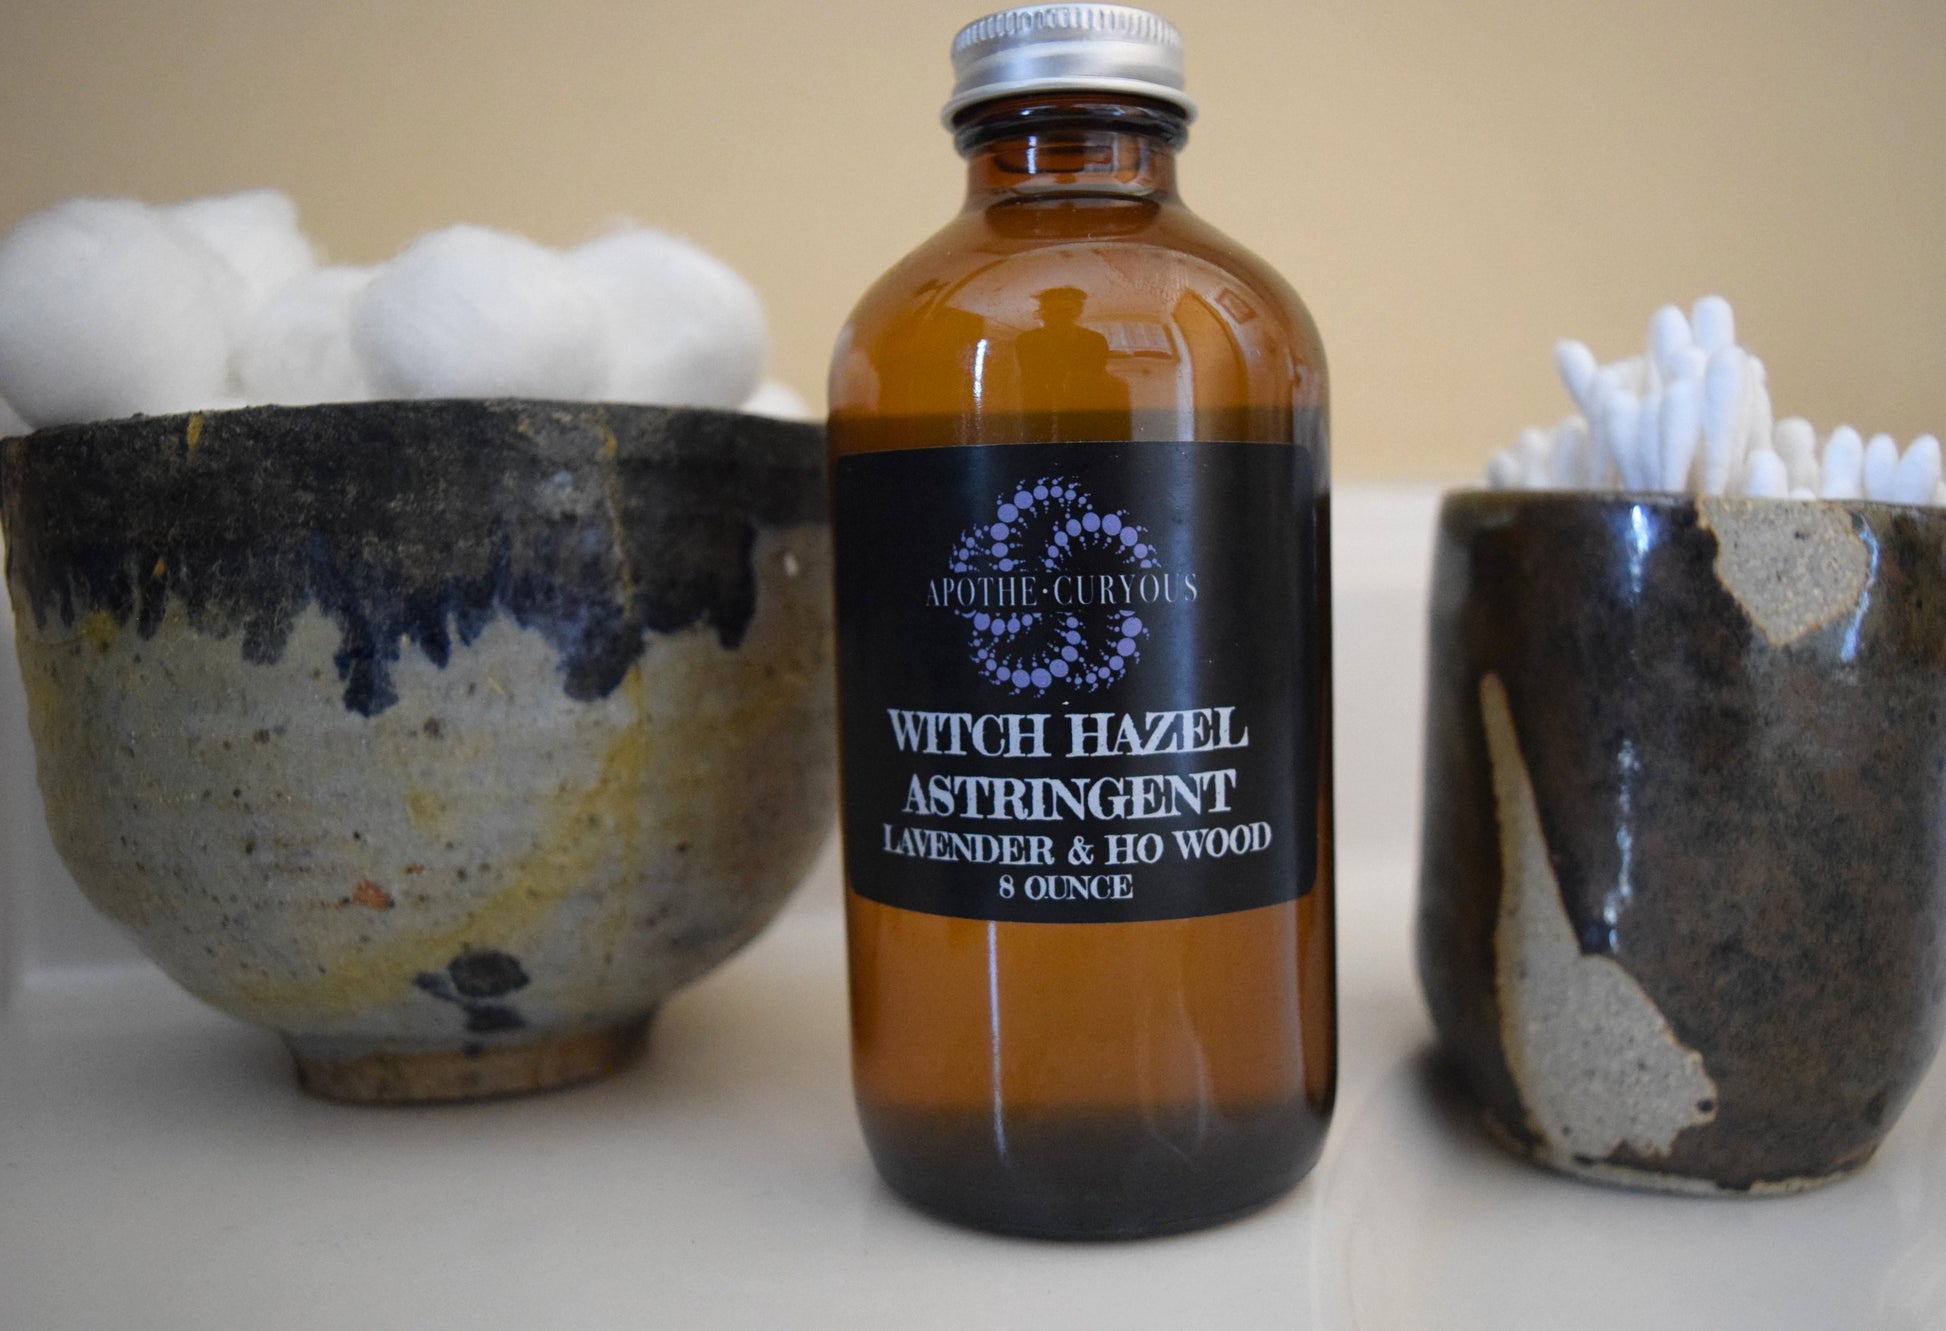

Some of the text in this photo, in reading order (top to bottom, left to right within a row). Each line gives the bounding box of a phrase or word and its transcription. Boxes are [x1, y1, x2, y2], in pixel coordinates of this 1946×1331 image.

[887, 706, 1250, 758] WITCH HAZEL
[902, 768, 1238, 821] ASTRINGENT
[882, 820, 1273, 866] LAVENDER & HO WOOD
[998, 873, 1135, 901] 8 OUNCE
